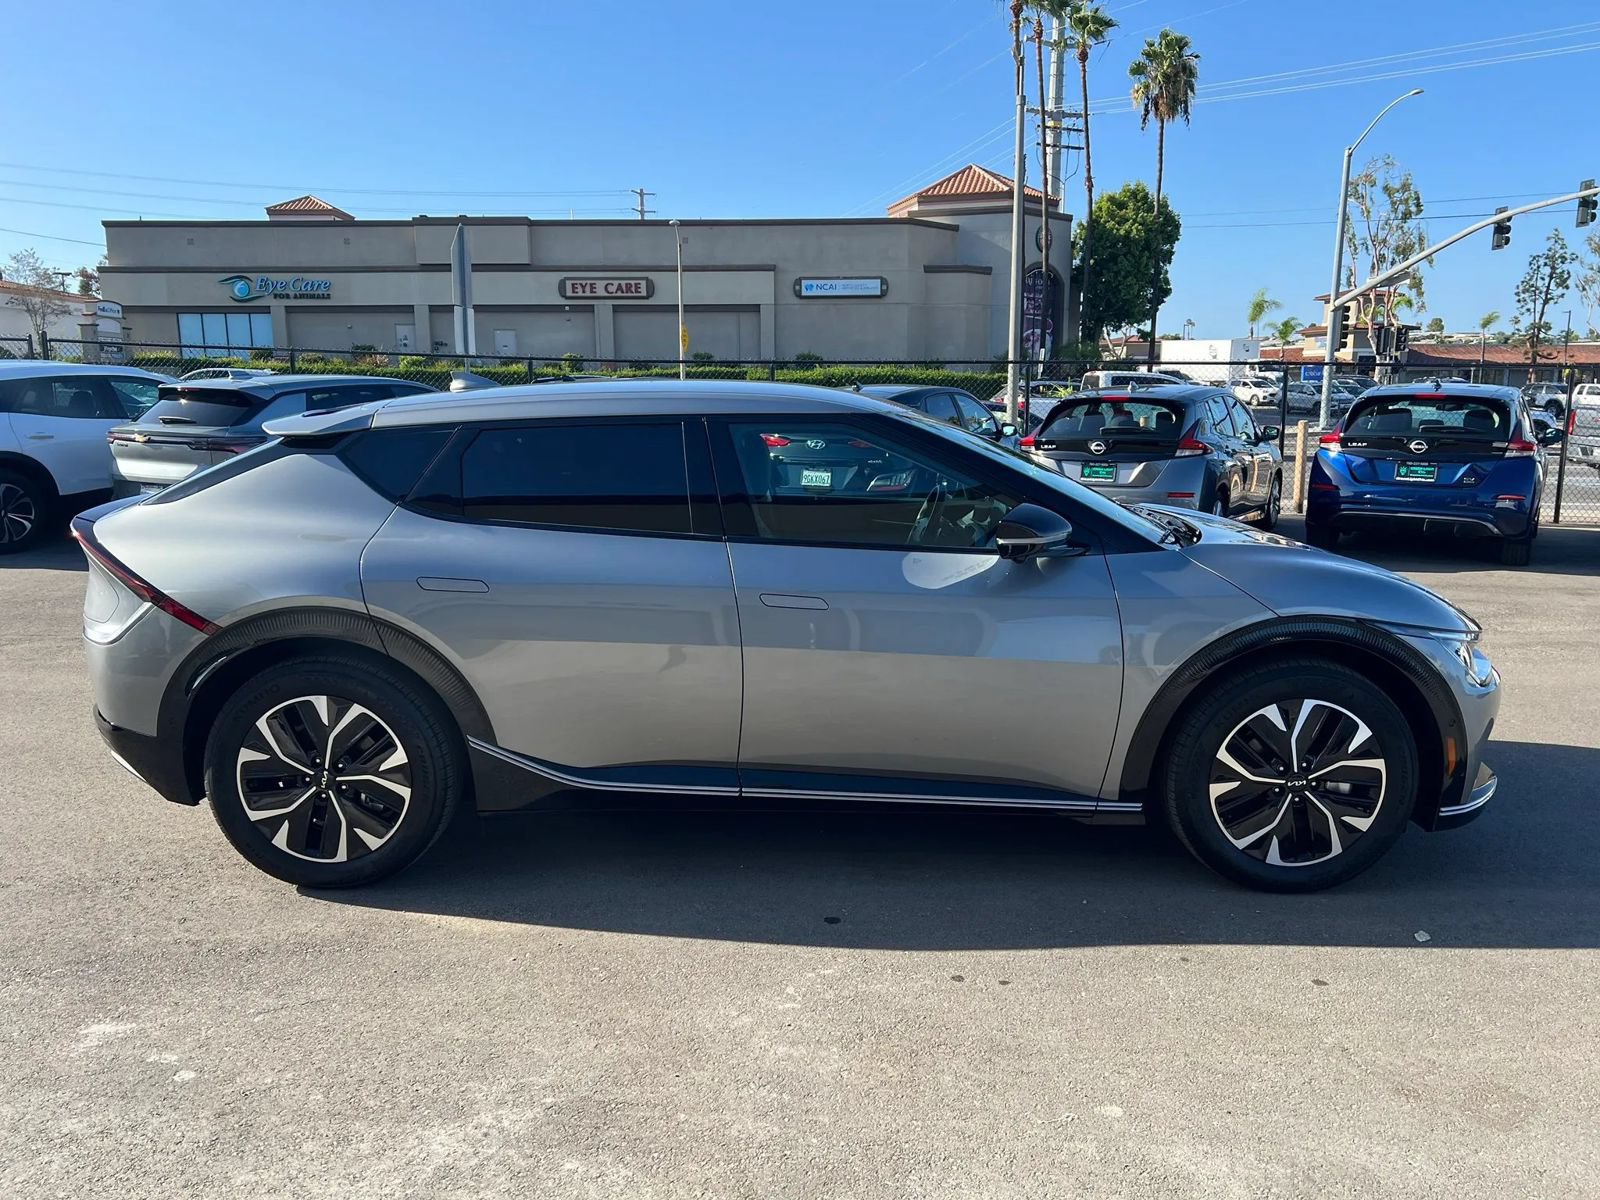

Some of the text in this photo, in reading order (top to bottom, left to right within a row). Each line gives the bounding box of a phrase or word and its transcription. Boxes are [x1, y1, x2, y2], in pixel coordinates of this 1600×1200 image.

[255, 276, 331, 296] Eye Care
[571, 282, 642, 294] EYE CARE
[815, 283, 837, 291] NCAI
